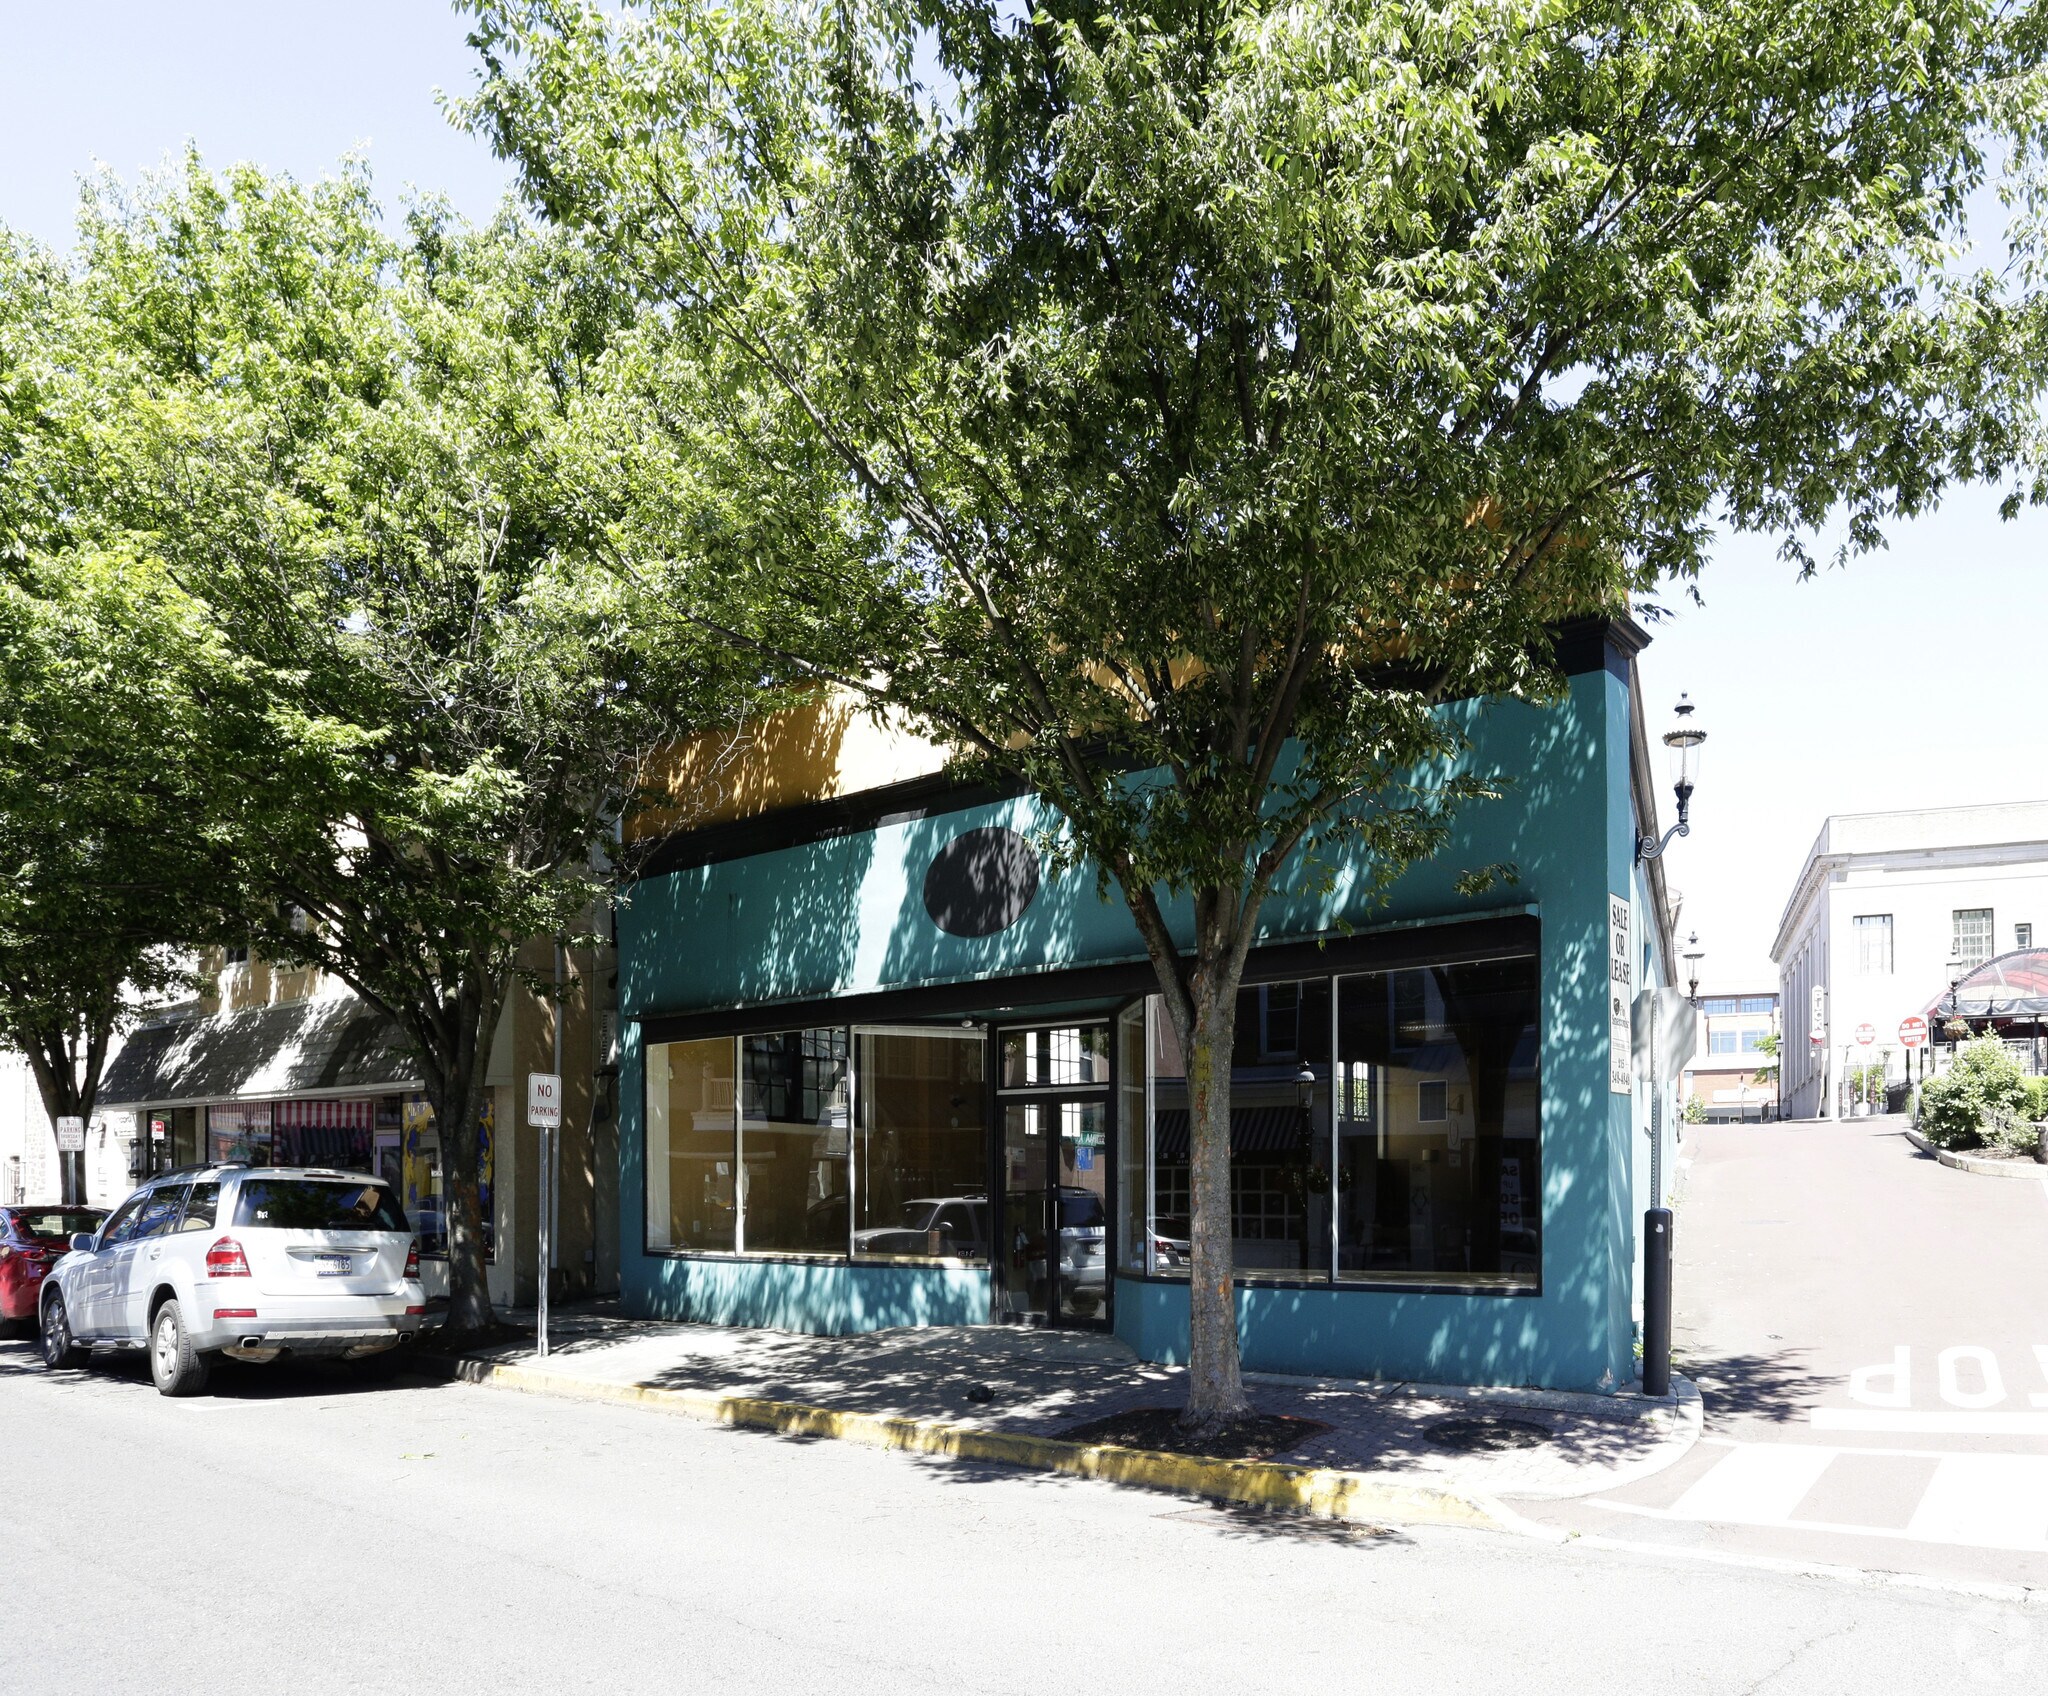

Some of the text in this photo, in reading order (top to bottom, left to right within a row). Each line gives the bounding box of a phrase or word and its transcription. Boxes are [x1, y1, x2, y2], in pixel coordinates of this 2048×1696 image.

[1612, 904, 1628, 931] SALE
[1615, 932, 1625, 957] OR
[1611, 958, 1630, 985] LEASE
[537, 1084, 552, 1097] NO
[531, 1105, 558, 1117] PARKING
